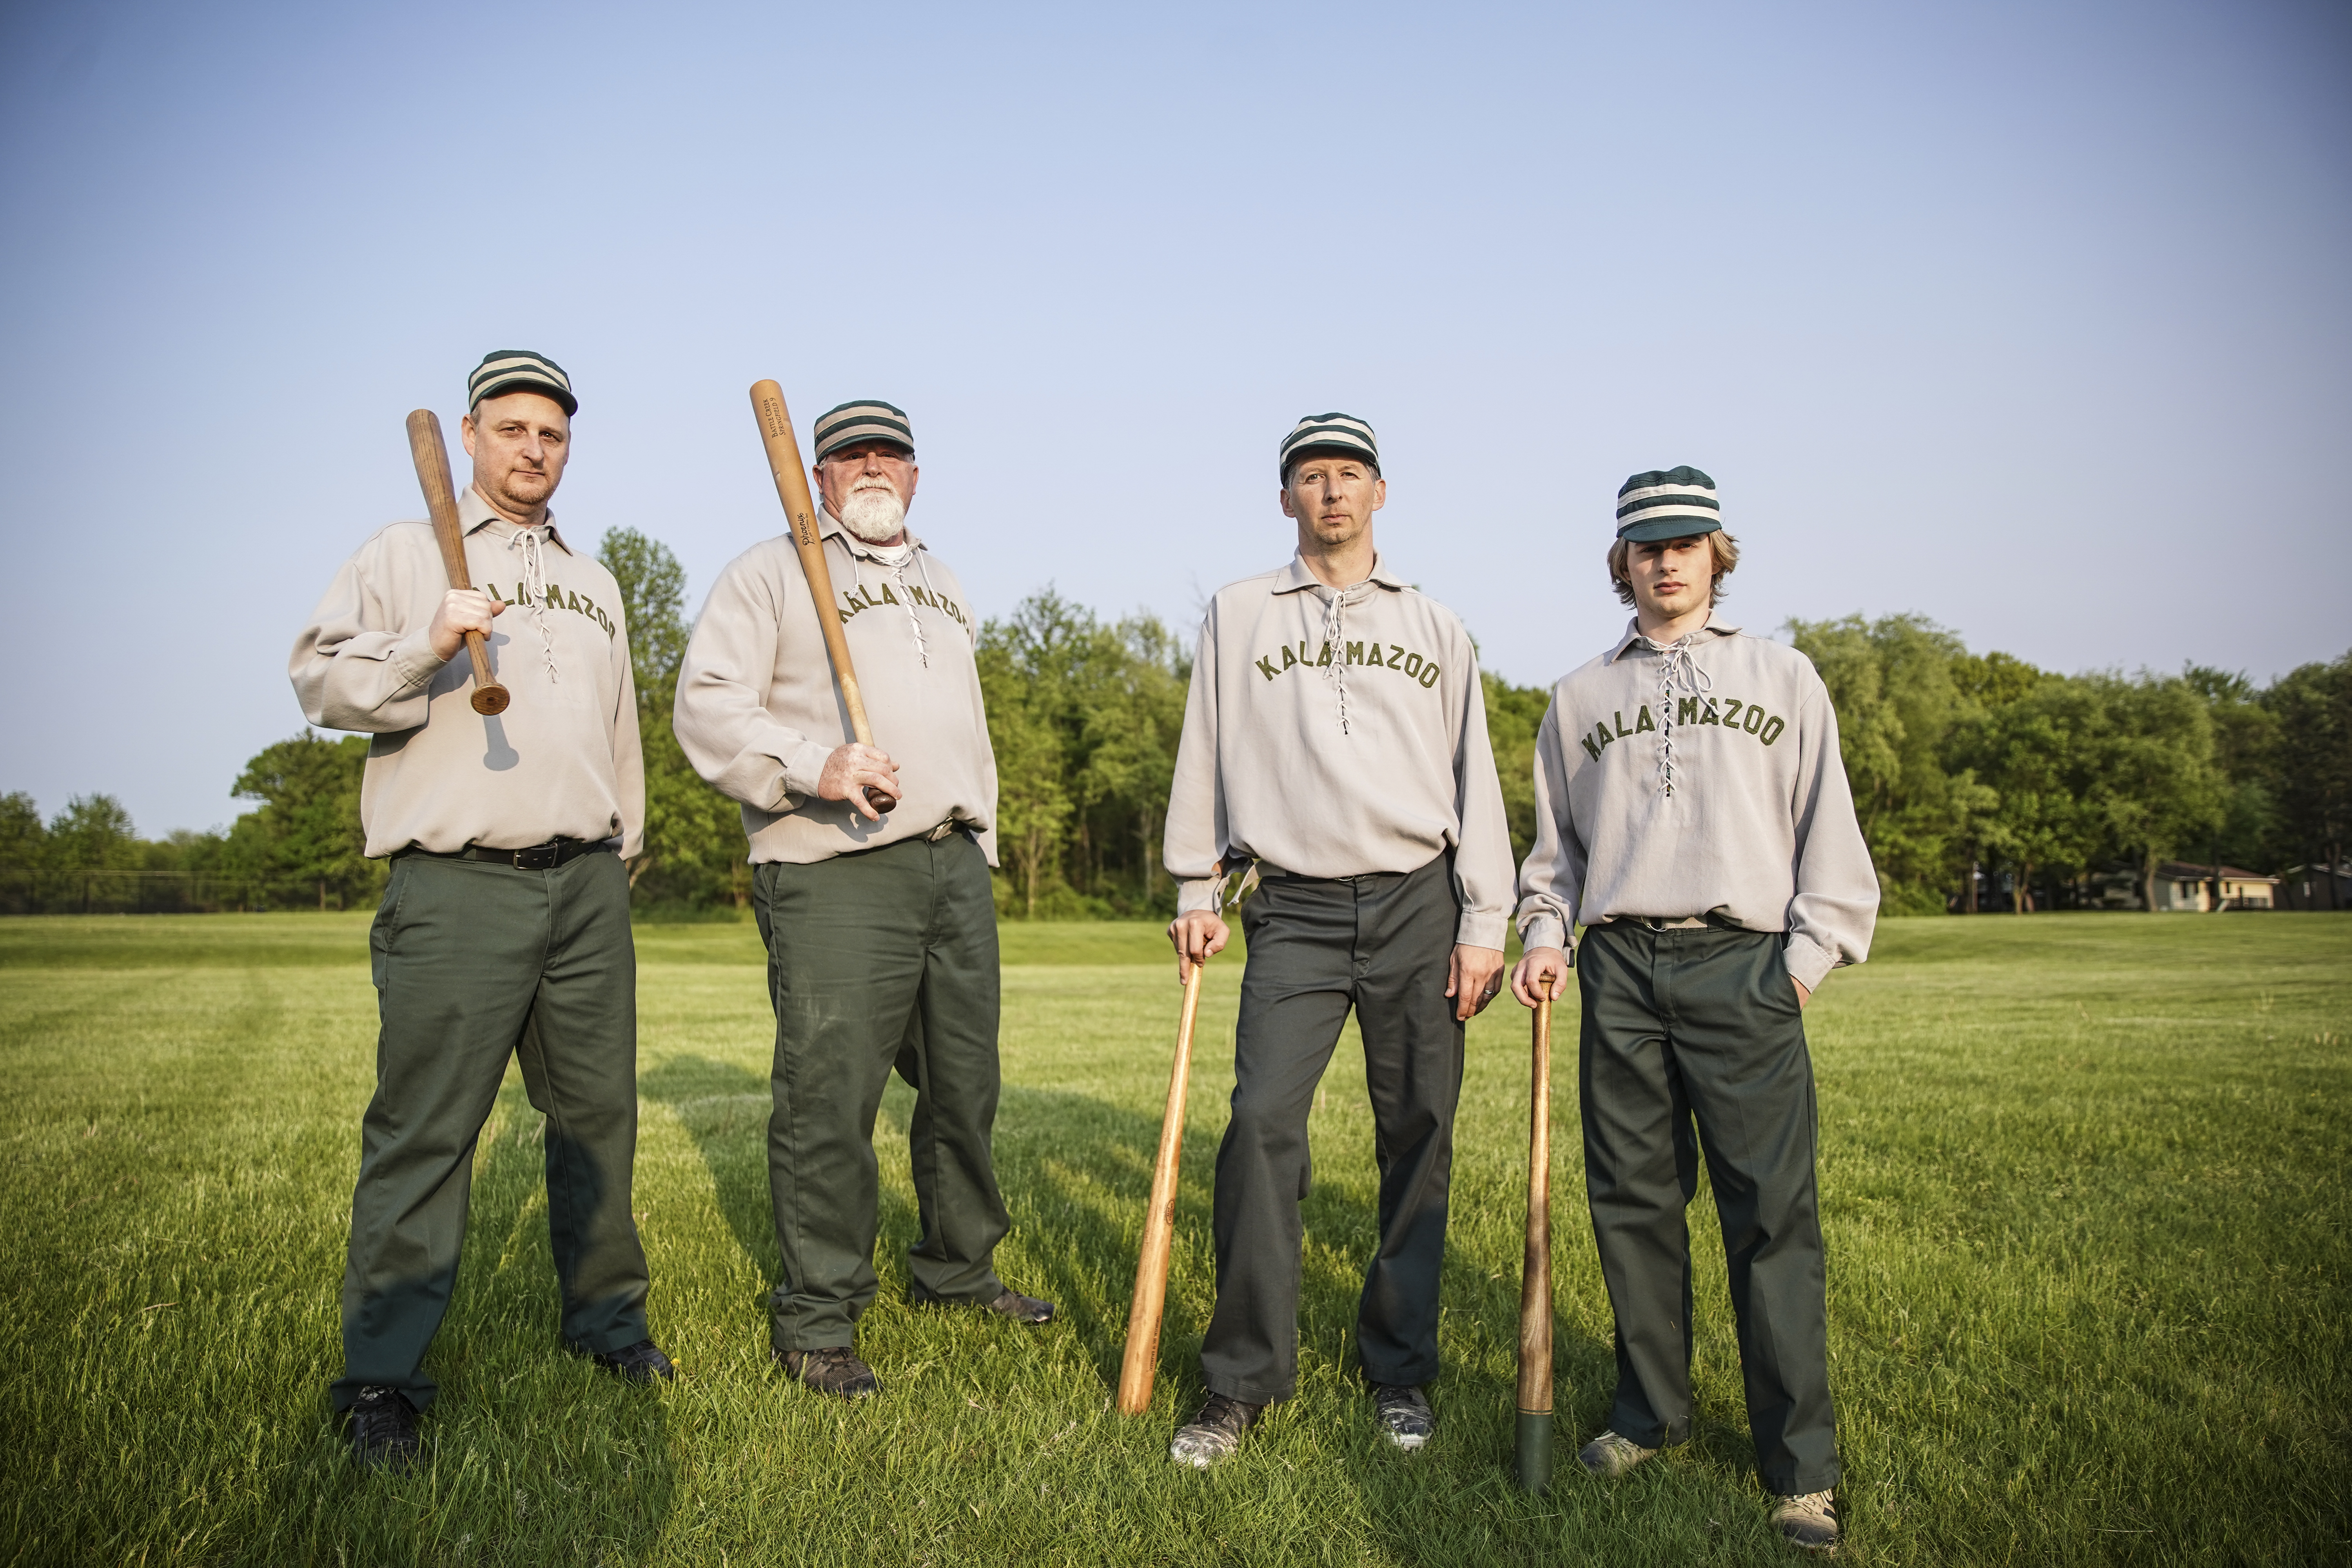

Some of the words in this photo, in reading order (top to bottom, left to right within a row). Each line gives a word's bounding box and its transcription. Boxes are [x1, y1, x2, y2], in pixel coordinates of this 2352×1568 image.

[763, 398, 772, 416] CREEK
[772, 403, 786, 435] SPRINGFIELD
[768, 417, 778, 438] BATTLE
[797, 513, 815, 545] Phoenix
[472, 582, 615, 644] LAMAZOO
